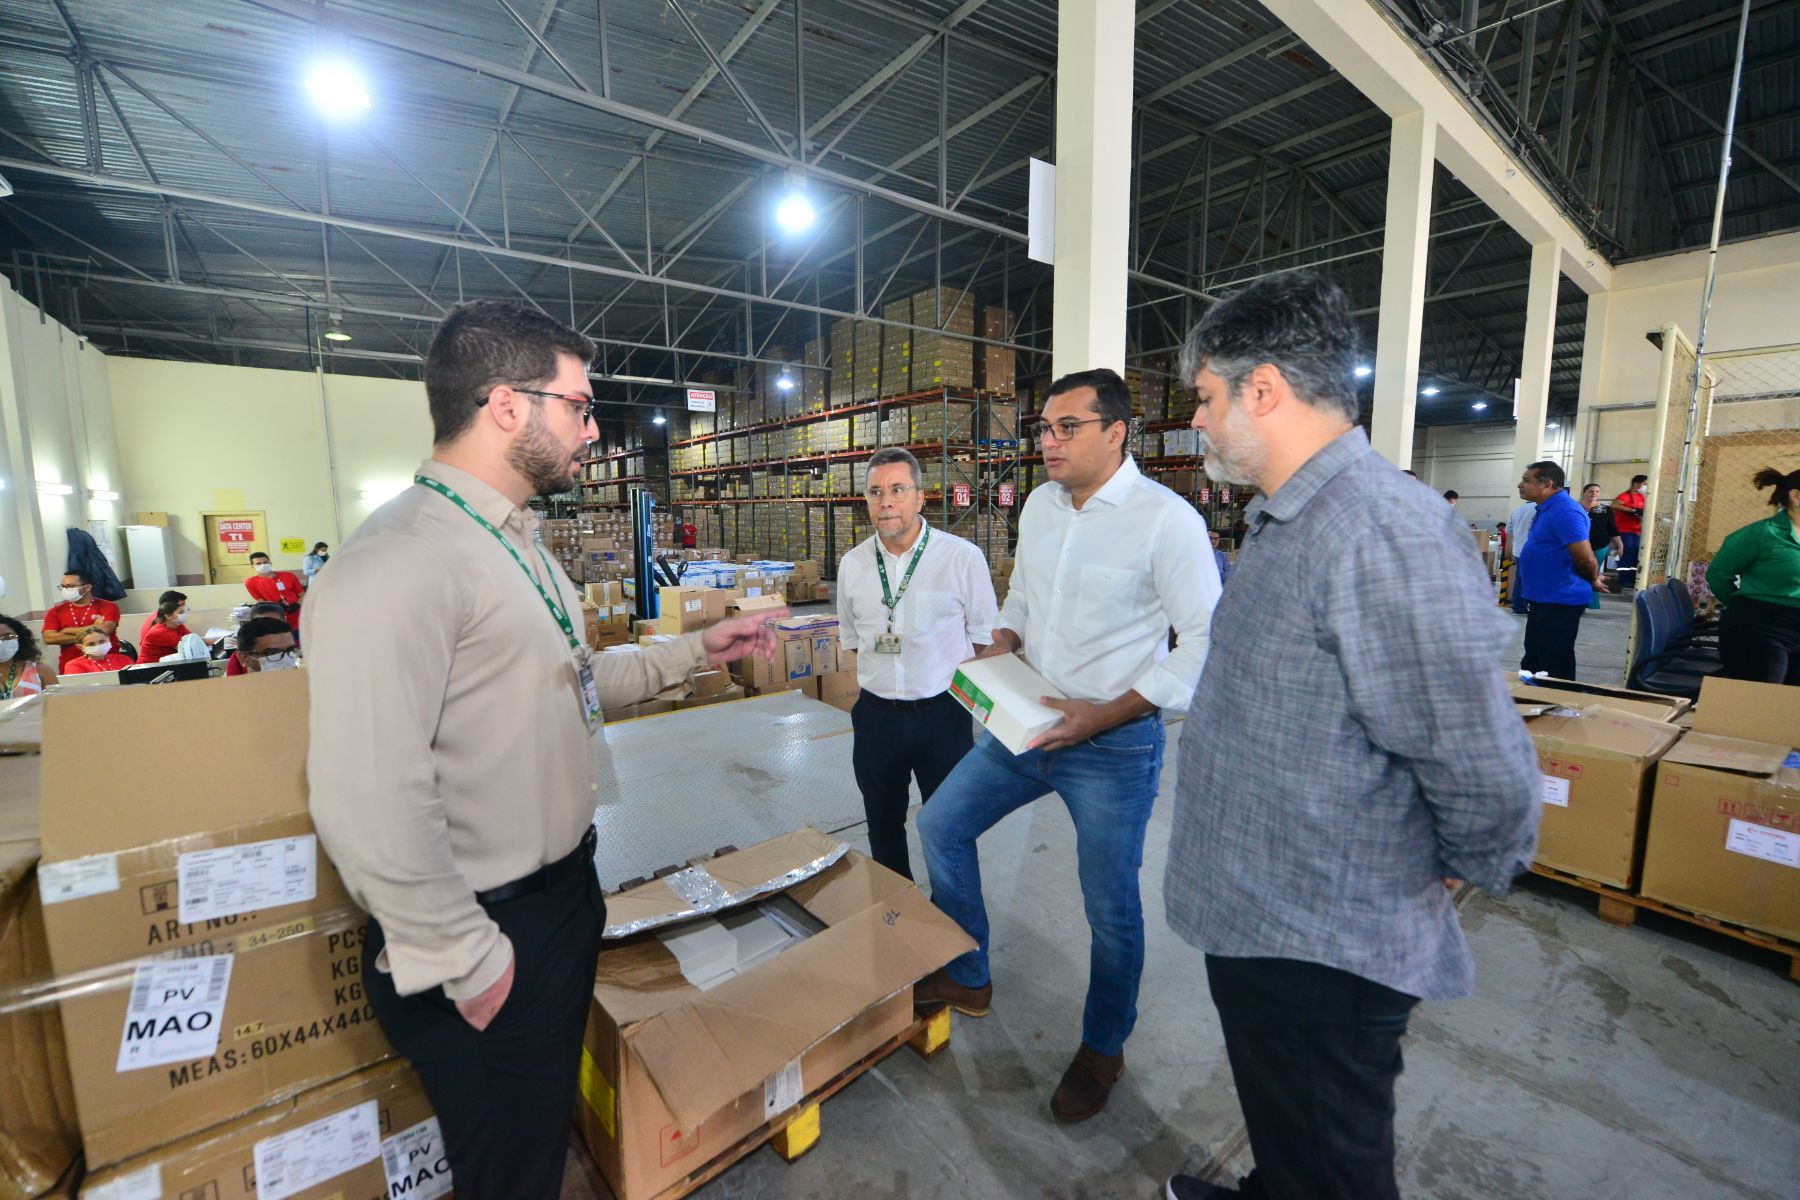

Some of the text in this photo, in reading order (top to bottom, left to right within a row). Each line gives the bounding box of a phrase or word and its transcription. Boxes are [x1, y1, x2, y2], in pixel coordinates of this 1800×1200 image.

[957, 492, 967, 502] 01
[1001, 492, 1011, 502] 02
[331, 956, 358, 980] KG
[163, 986, 195, 1003] PV
[334, 982, 362, 1006] KG
[126, 1011, 212, 1042] MAO
[235, 1022, 264, 1038] 14.7
[408, 1142, 431, 1163] PV
